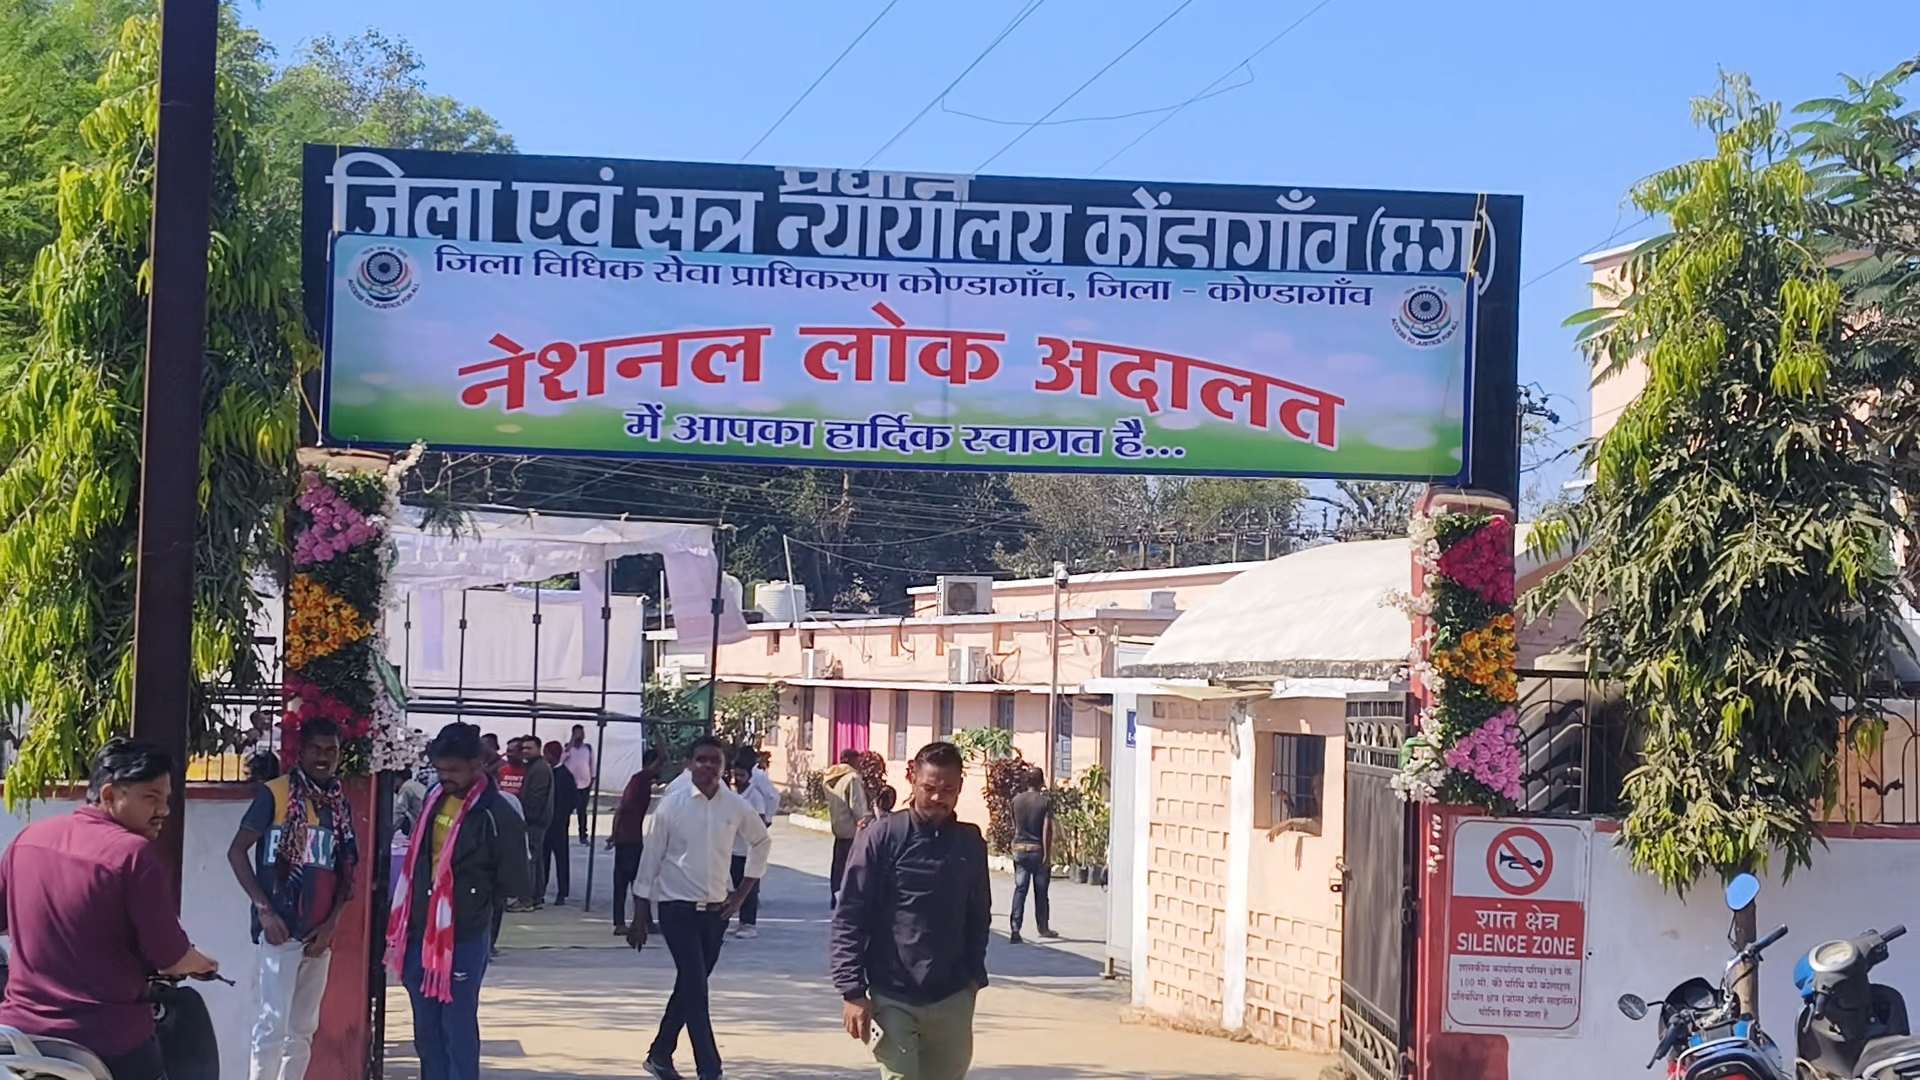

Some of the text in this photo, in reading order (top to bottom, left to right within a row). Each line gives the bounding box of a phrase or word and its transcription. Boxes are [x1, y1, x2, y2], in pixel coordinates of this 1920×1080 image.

[325, 152, 501, 242] जिला
[512, 166, 623, 247] एवं
[637, 187, 764, 254] सत्र
[777, 194, 1073, 264] न्यायालय
[436, 245, 524, 275] जिला
[534, 249, 643, 280] विधिक
[654, 255, 721, 284] सेवा
[731, 260, 888, 292] प्राधिकरण
[1088, 272, 1171, 300] जिला
[1208, 276, 1373, 306] कोण्डागाँव
[458, 302, 1345, 447] नेशनल लोक अदालत
[625, 403, 662, 439] में
[673, 415, 815, 445] आपका
[825, 415, 952, 452] हार्दिक
[962, 427, 1103, 455] स्वागत
[1457, 933, 1575, 955] SILENCE ZONE
[1475, 904, 1560, 933] शांत क्षेत्र
